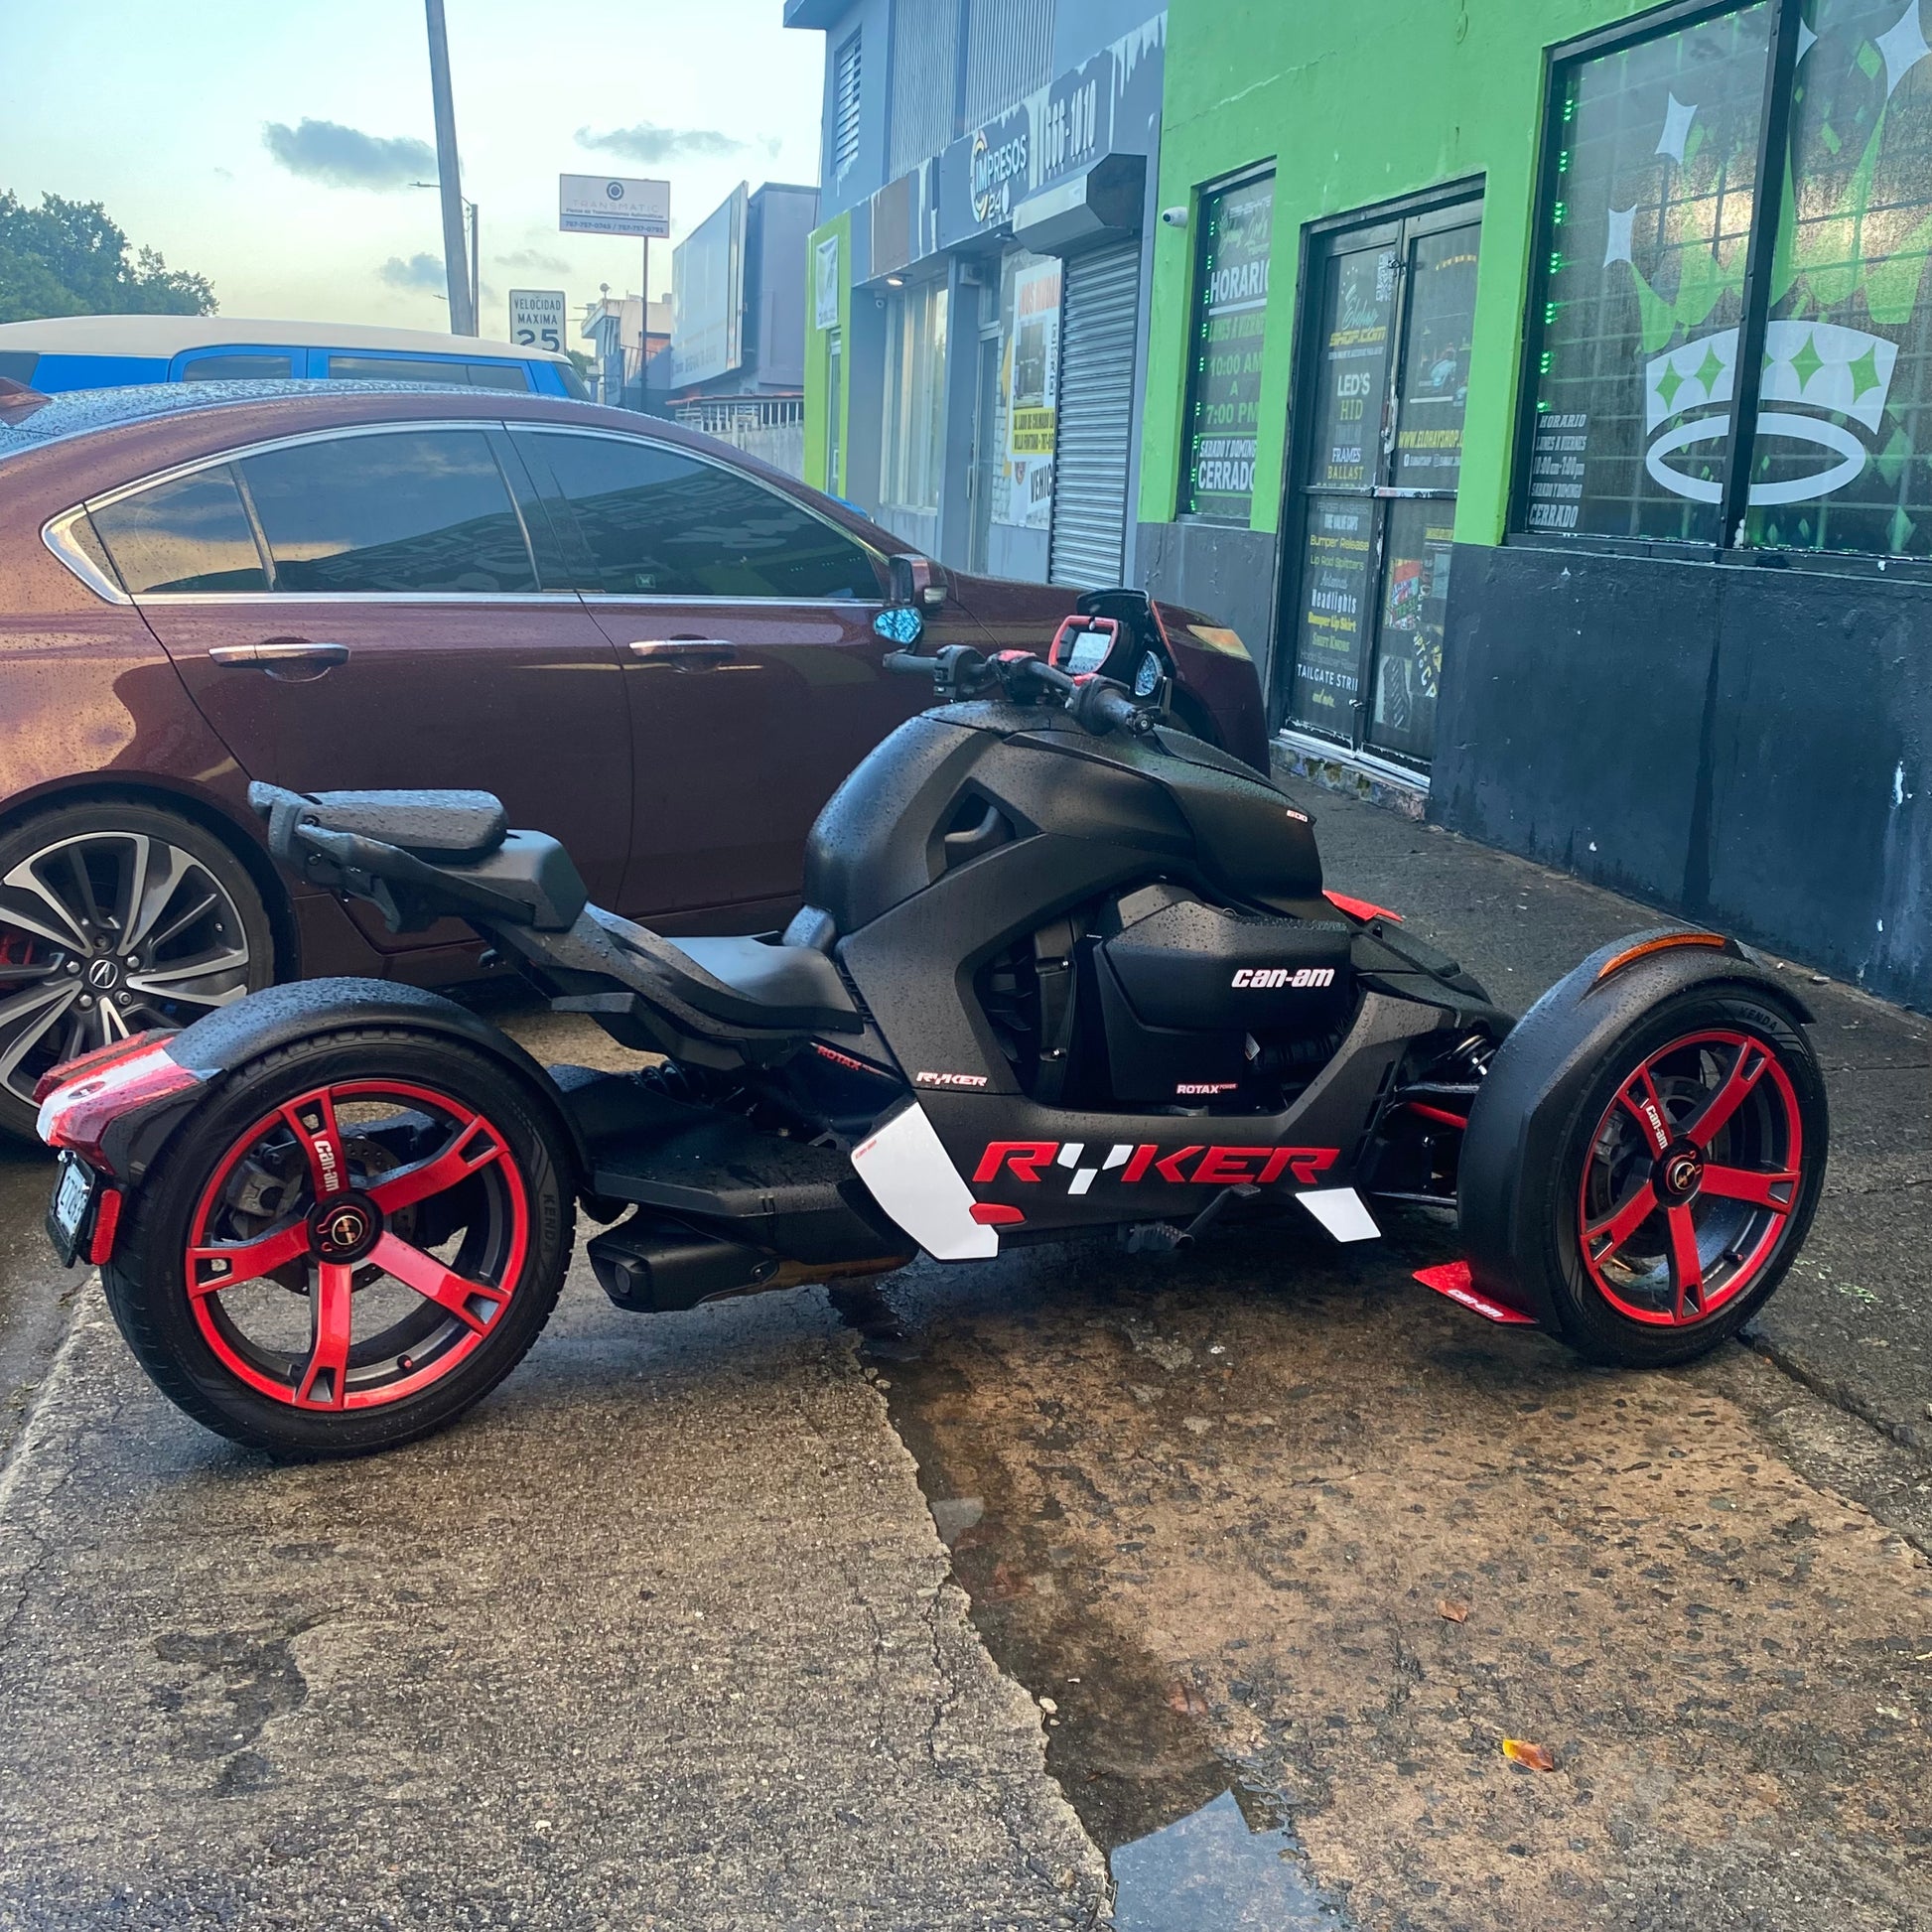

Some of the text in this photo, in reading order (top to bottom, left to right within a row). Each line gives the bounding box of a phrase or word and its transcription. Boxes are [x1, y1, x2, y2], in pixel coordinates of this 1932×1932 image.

[975, 134, 1028, 193] IMPRESOS
[573, 199, 660, 213] TRANSMATIC
[514, 299, 561, 311] VELOCIDAD
[517, 313, 558, 326] MAXIMA
[516, 329, 560, 352] 25
[1210, 353, 1241, 377] 10:00
[1230, 380, 1239, 396] A
[1337, 372, 1371, 397] LED'S
[1206, 402, 1234, 426] 7:00
[1340, 399, 1364, 421] HID
[1539, 414, 1587, 428] HORARIO
[1331, 448, 1361, 464] FRAMES
[1327, 466, 1364, 481] BALLAST
[1529, 503, 1579, 528] CERRADO
[1311, 534, 1369, 552] Bumper Release
[1311, 589, 1357, 614] Headlights
[1298, 663, 1334, 685] TAILGATE
[1231, 968, 1335, 988] can-am
[1739, 1005, 1778, 1033] KENDA
[915, 1071, 989, 1088] RYKER
[1176, 1083, 1219, 1095] ROTAX
[1645, 1104, 1670, 1150] can-am
[314, 1140, 341, 1192] can-am
[971, 1141, 1340, 1195] RYKER
